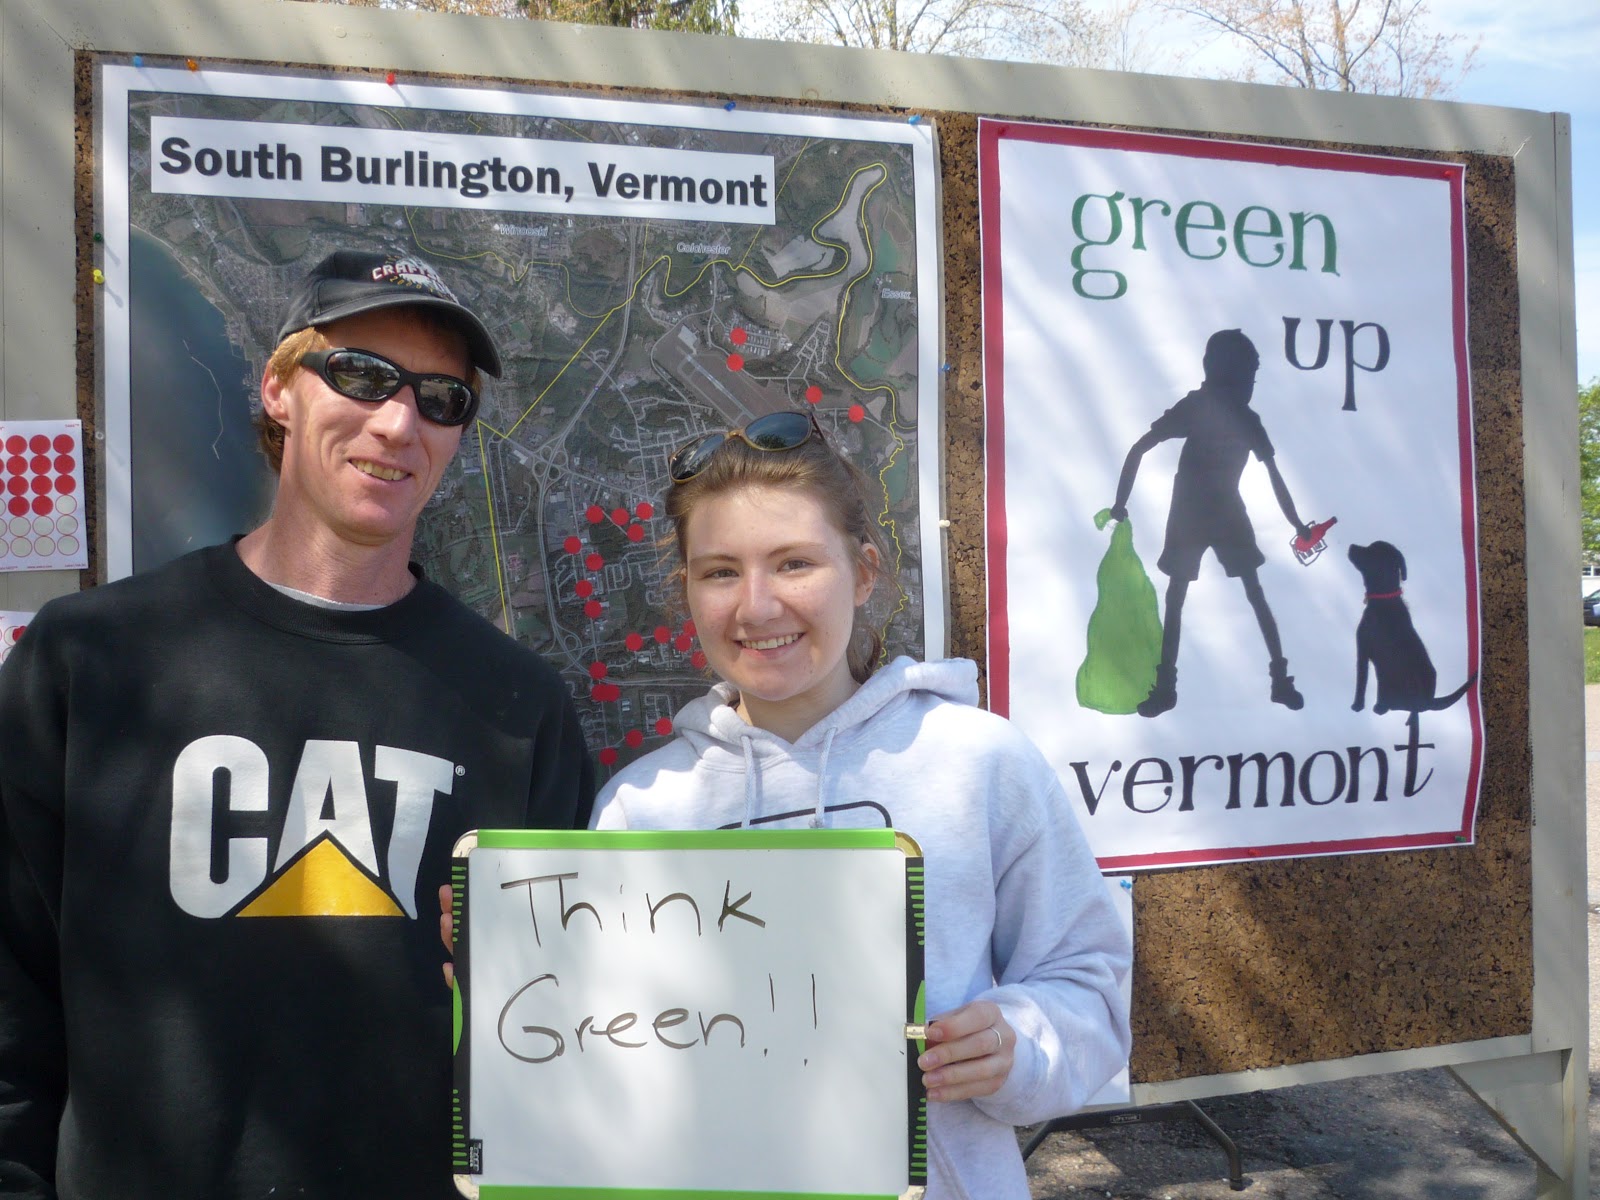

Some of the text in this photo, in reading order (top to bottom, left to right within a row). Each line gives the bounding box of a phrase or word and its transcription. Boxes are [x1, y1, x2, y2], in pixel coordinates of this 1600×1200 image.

[159, 136, 768, 206] South Burlington, Vermont
[1071, 190, 1340, 300] green
[1282, 316, 1390, 411] up
[1069, 711, 1435, 816] vermont
[500, 871, 766, 948] Think
